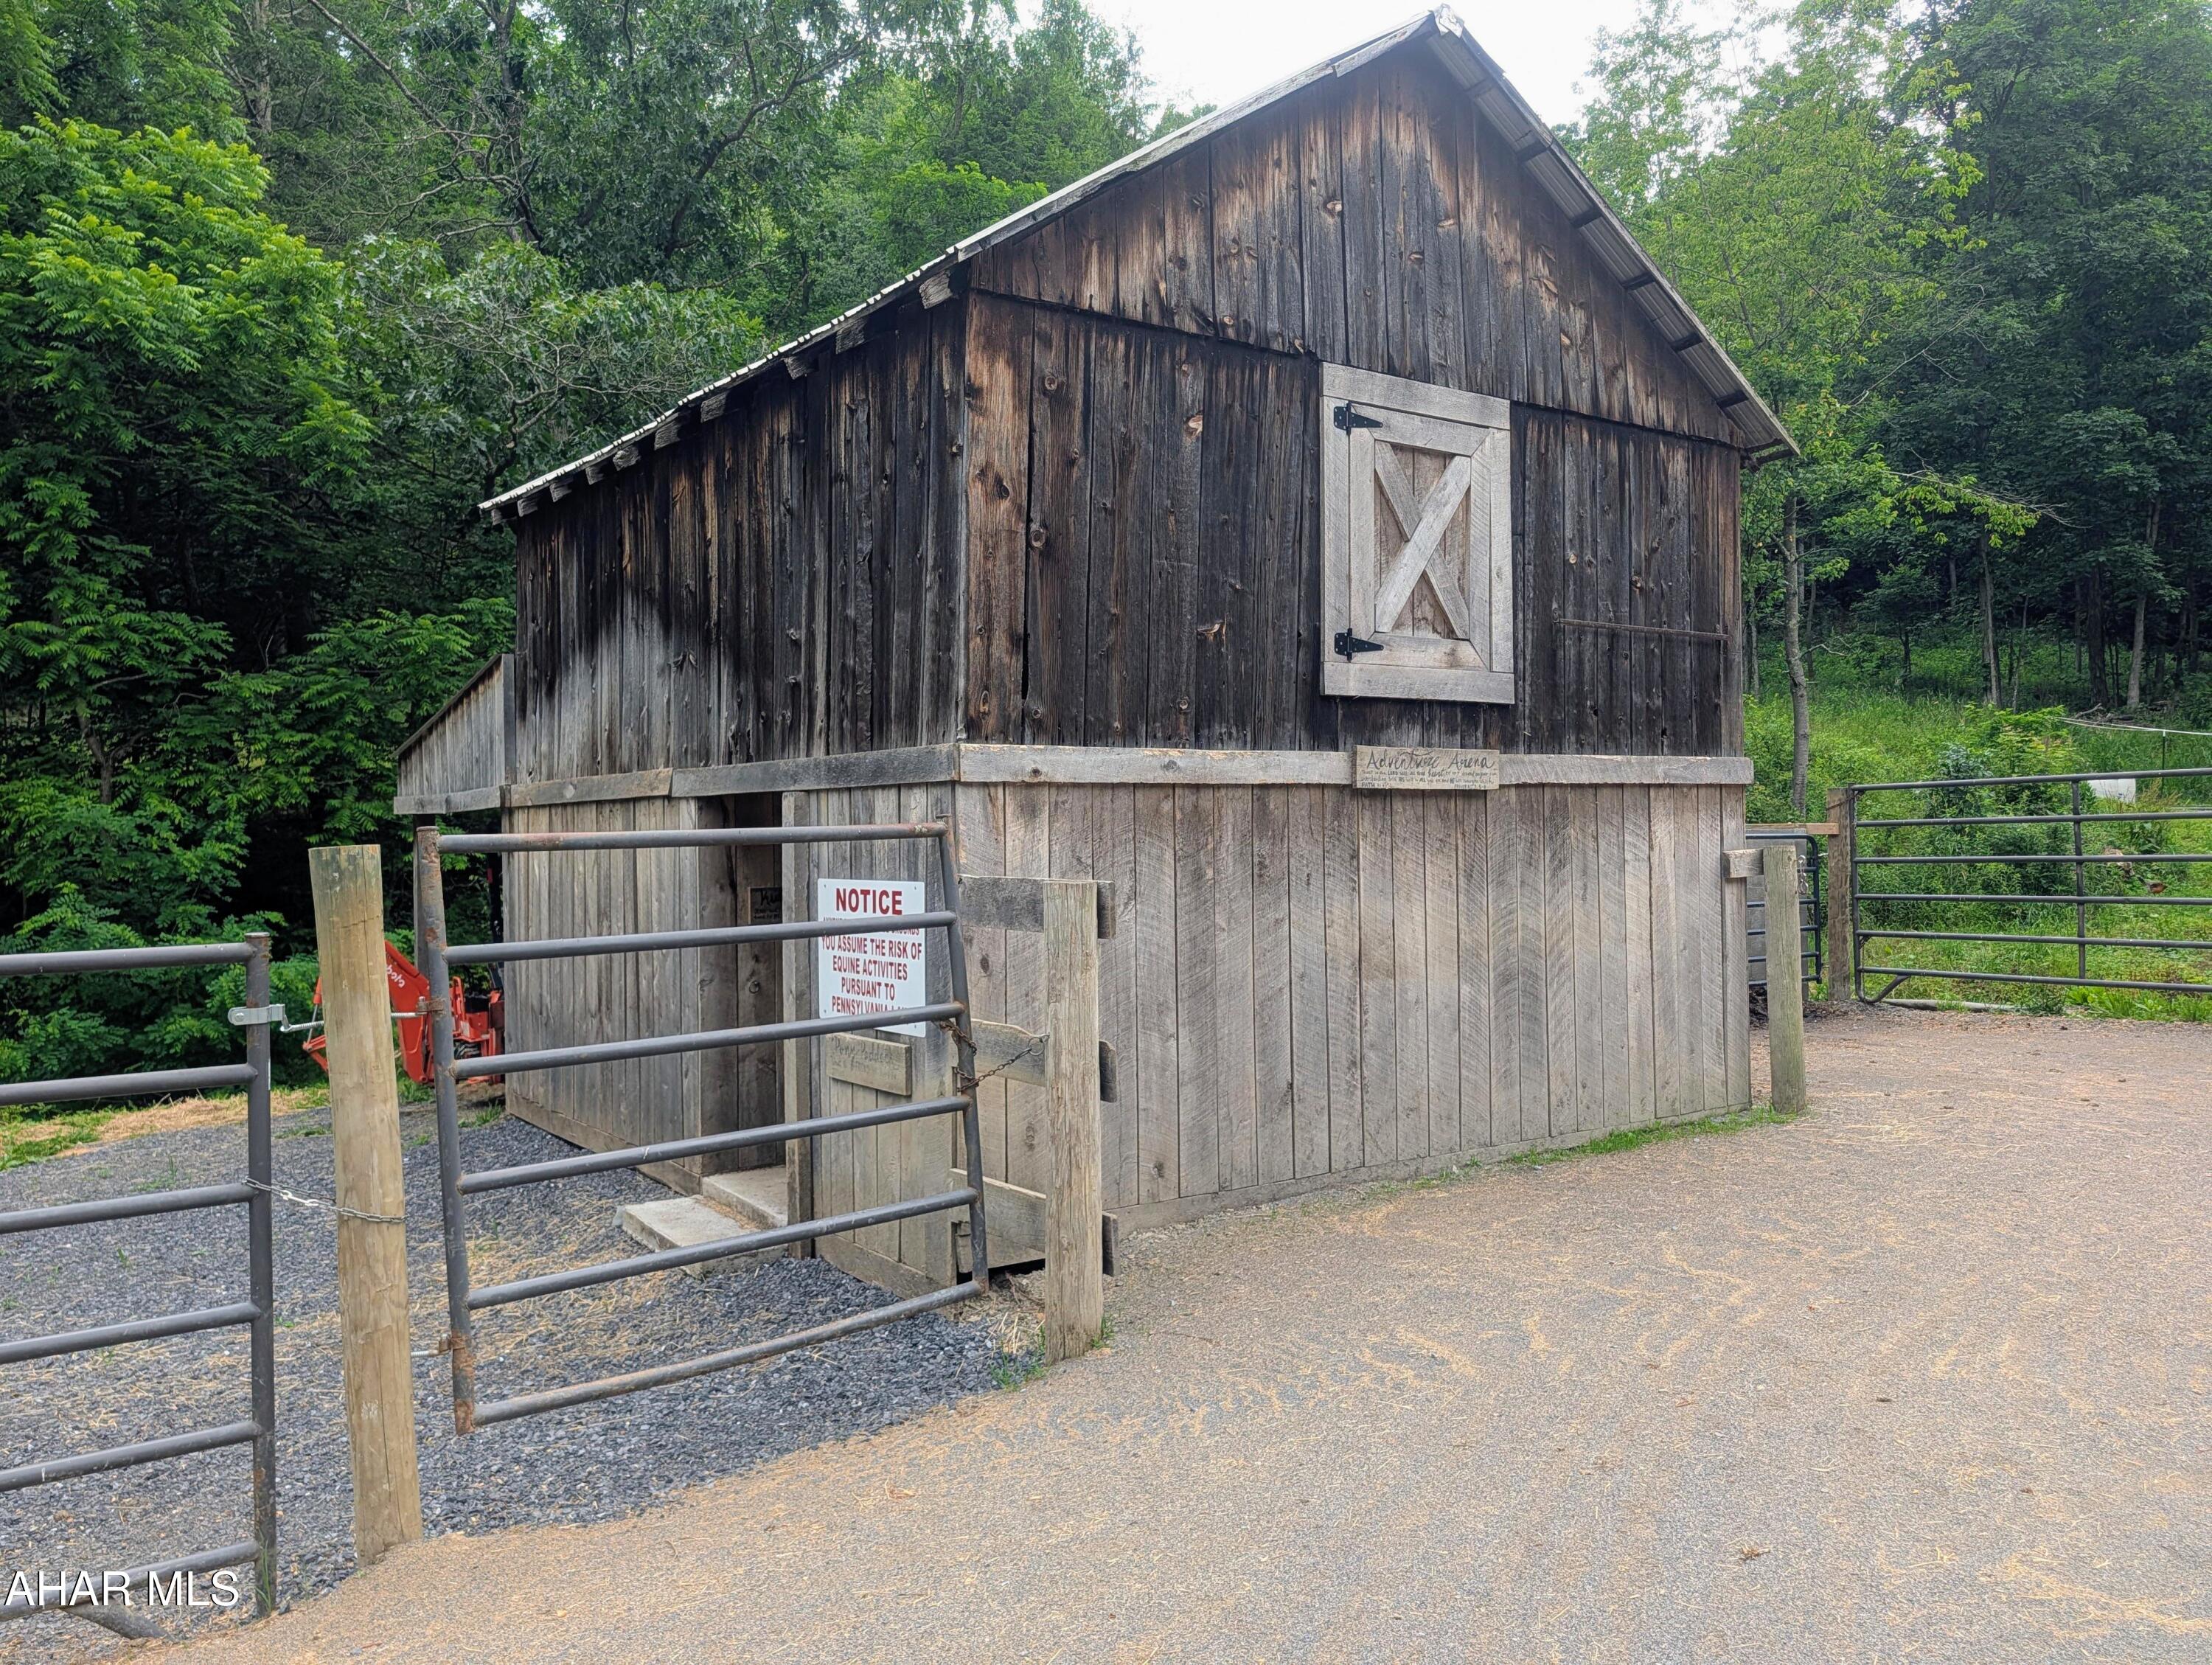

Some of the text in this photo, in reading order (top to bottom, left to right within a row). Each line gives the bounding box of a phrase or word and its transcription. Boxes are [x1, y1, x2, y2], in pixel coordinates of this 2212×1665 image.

[1366, 748, 1495, 771] Adventure Arena
[835, 888, 902, 915] NOTICE
[821, 935, 922, 961] YOU ASSUME THE RISK OF
[832, 955, 908, 981] EQUINE ACTIVITIES
[841, 976, 895, 1001] PURSUANT TO
